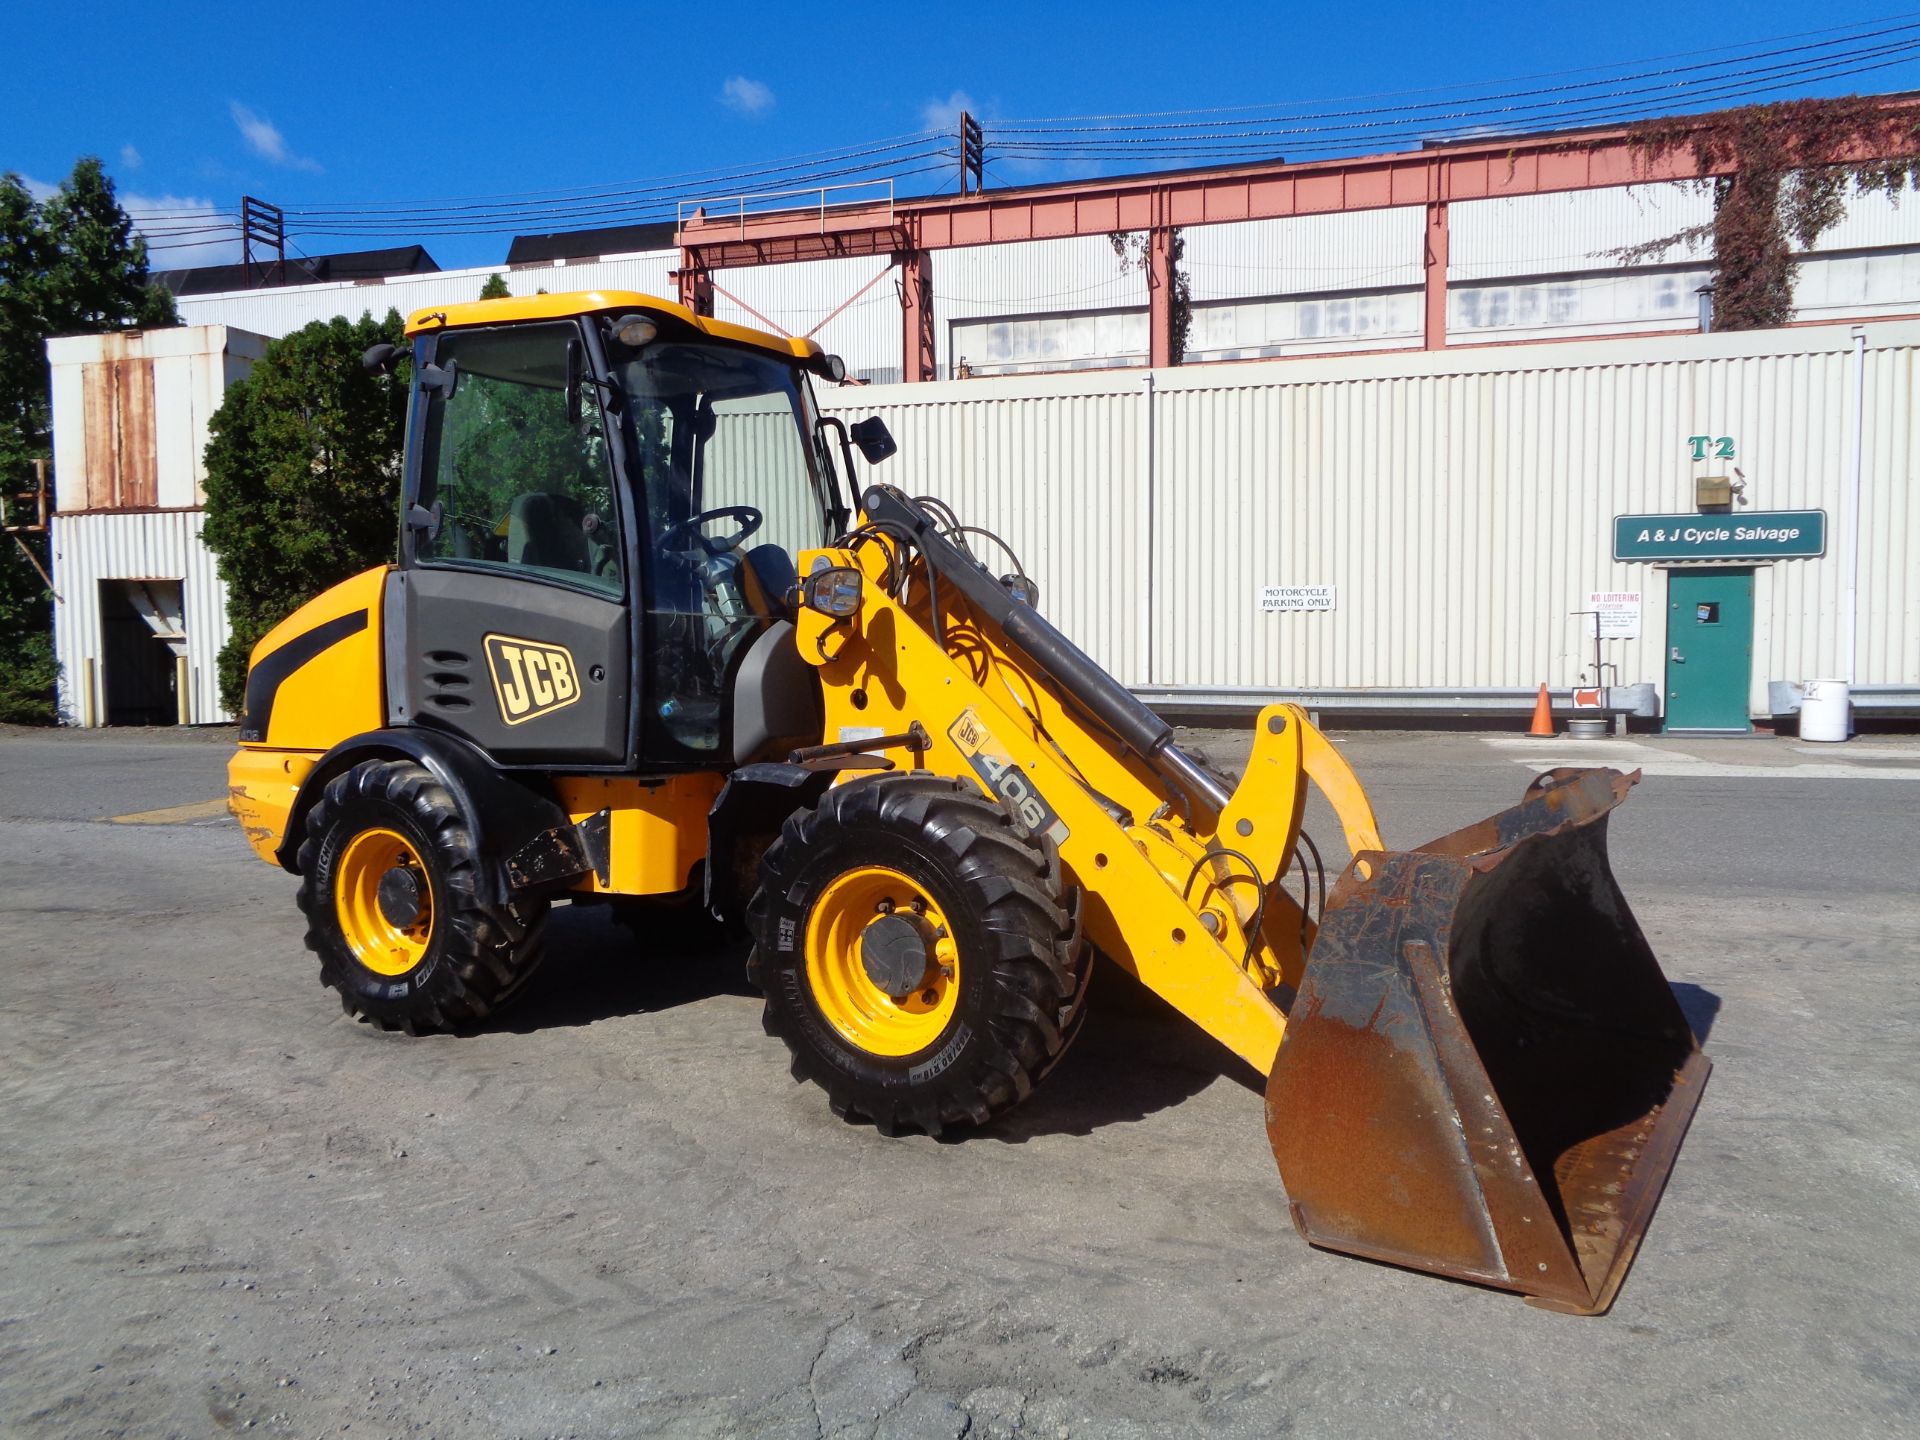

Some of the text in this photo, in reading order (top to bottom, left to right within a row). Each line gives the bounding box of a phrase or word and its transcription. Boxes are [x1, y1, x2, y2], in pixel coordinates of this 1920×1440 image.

[1688, 435, 1736, 460] T2
[1637, 526, 1800, 544] A & J Cycle Salvage
[1262, 598, 1332, 607] PARKING ONLY
[1265, 588, 1328, 597] MOTORCYCLE
[1591, 593, 1640, 603] NO LOITERING
[501, 646, 573, 714] JCB
[960, 721, 978, 745] JCB
[981, 755, 1046, 829] 406
